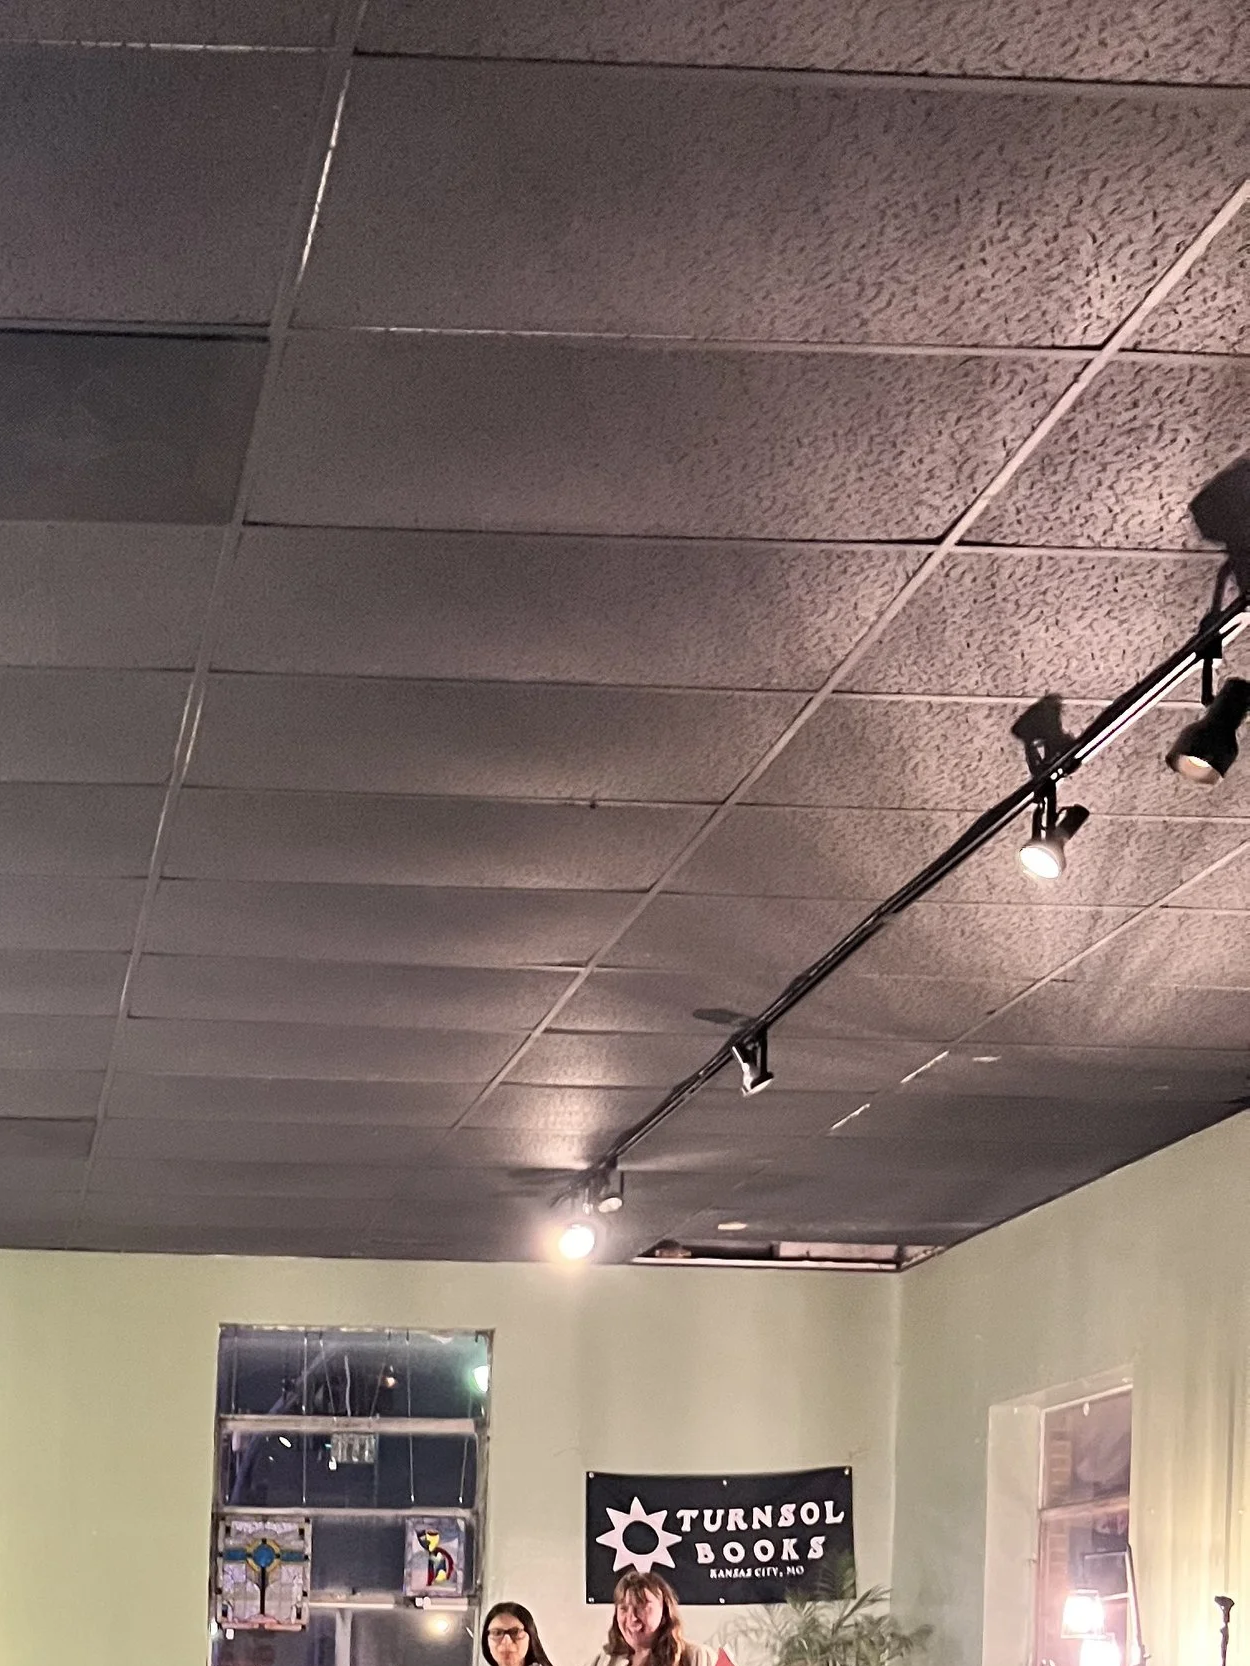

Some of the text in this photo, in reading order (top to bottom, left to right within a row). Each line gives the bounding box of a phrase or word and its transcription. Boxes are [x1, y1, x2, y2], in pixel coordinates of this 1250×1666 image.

[676, 1501, 844, 1533] TURNSOL
[695, 1536, 825, 1564] BOOKS
[710, 1565, 805, 1579] KANSAS CITY, MO
